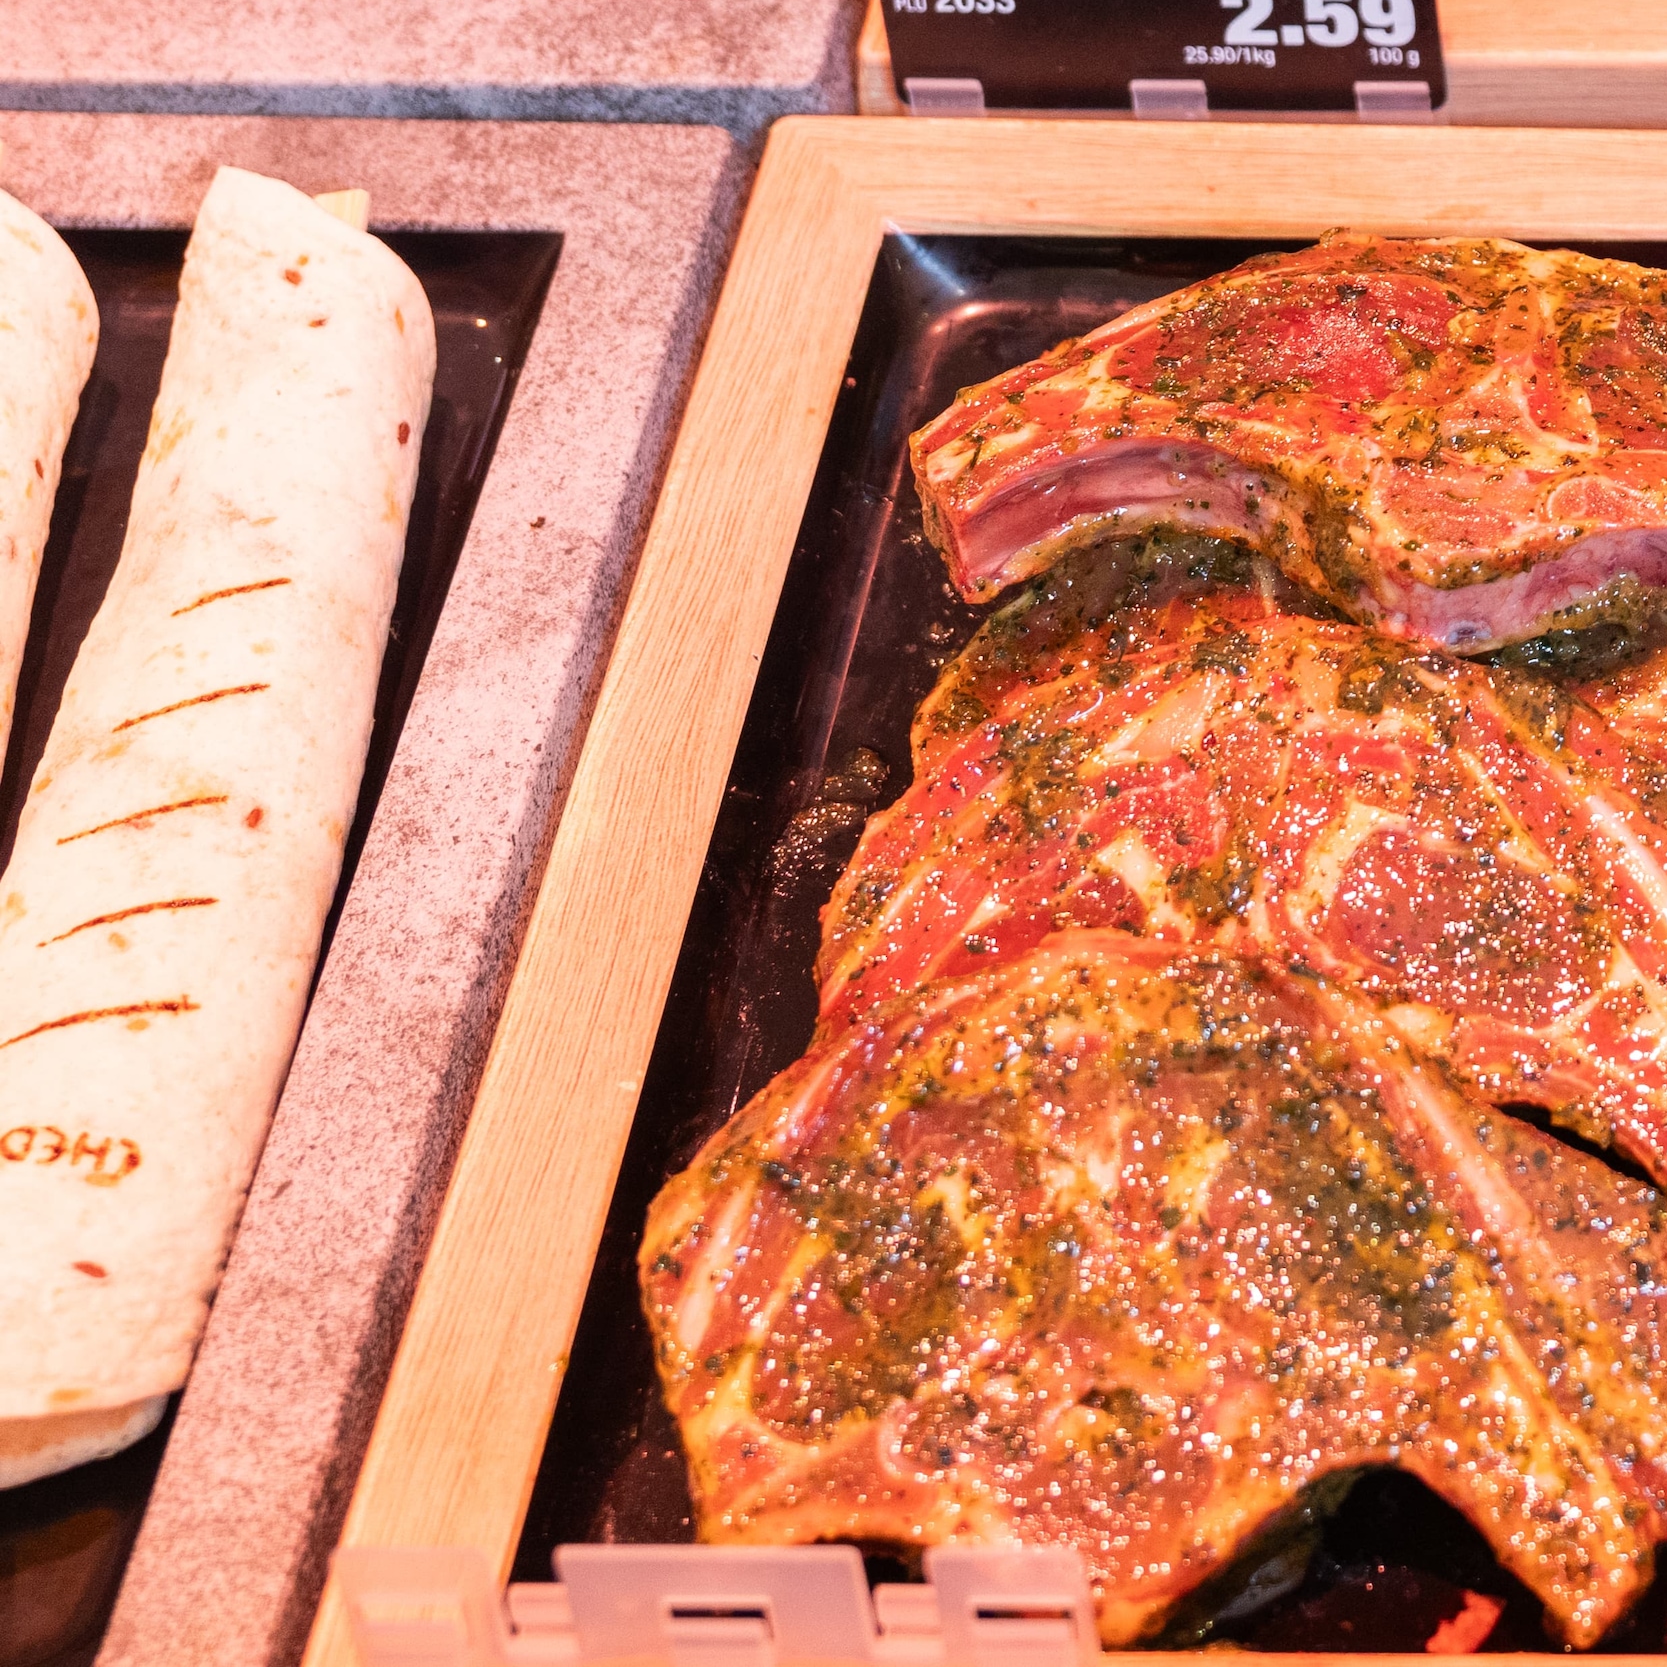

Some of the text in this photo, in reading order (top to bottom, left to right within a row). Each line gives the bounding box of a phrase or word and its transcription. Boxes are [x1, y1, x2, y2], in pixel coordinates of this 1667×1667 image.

[1183, 46, 1276, 68] 25.90/1kg
[1369, 47, 1420, 68] 100 g
